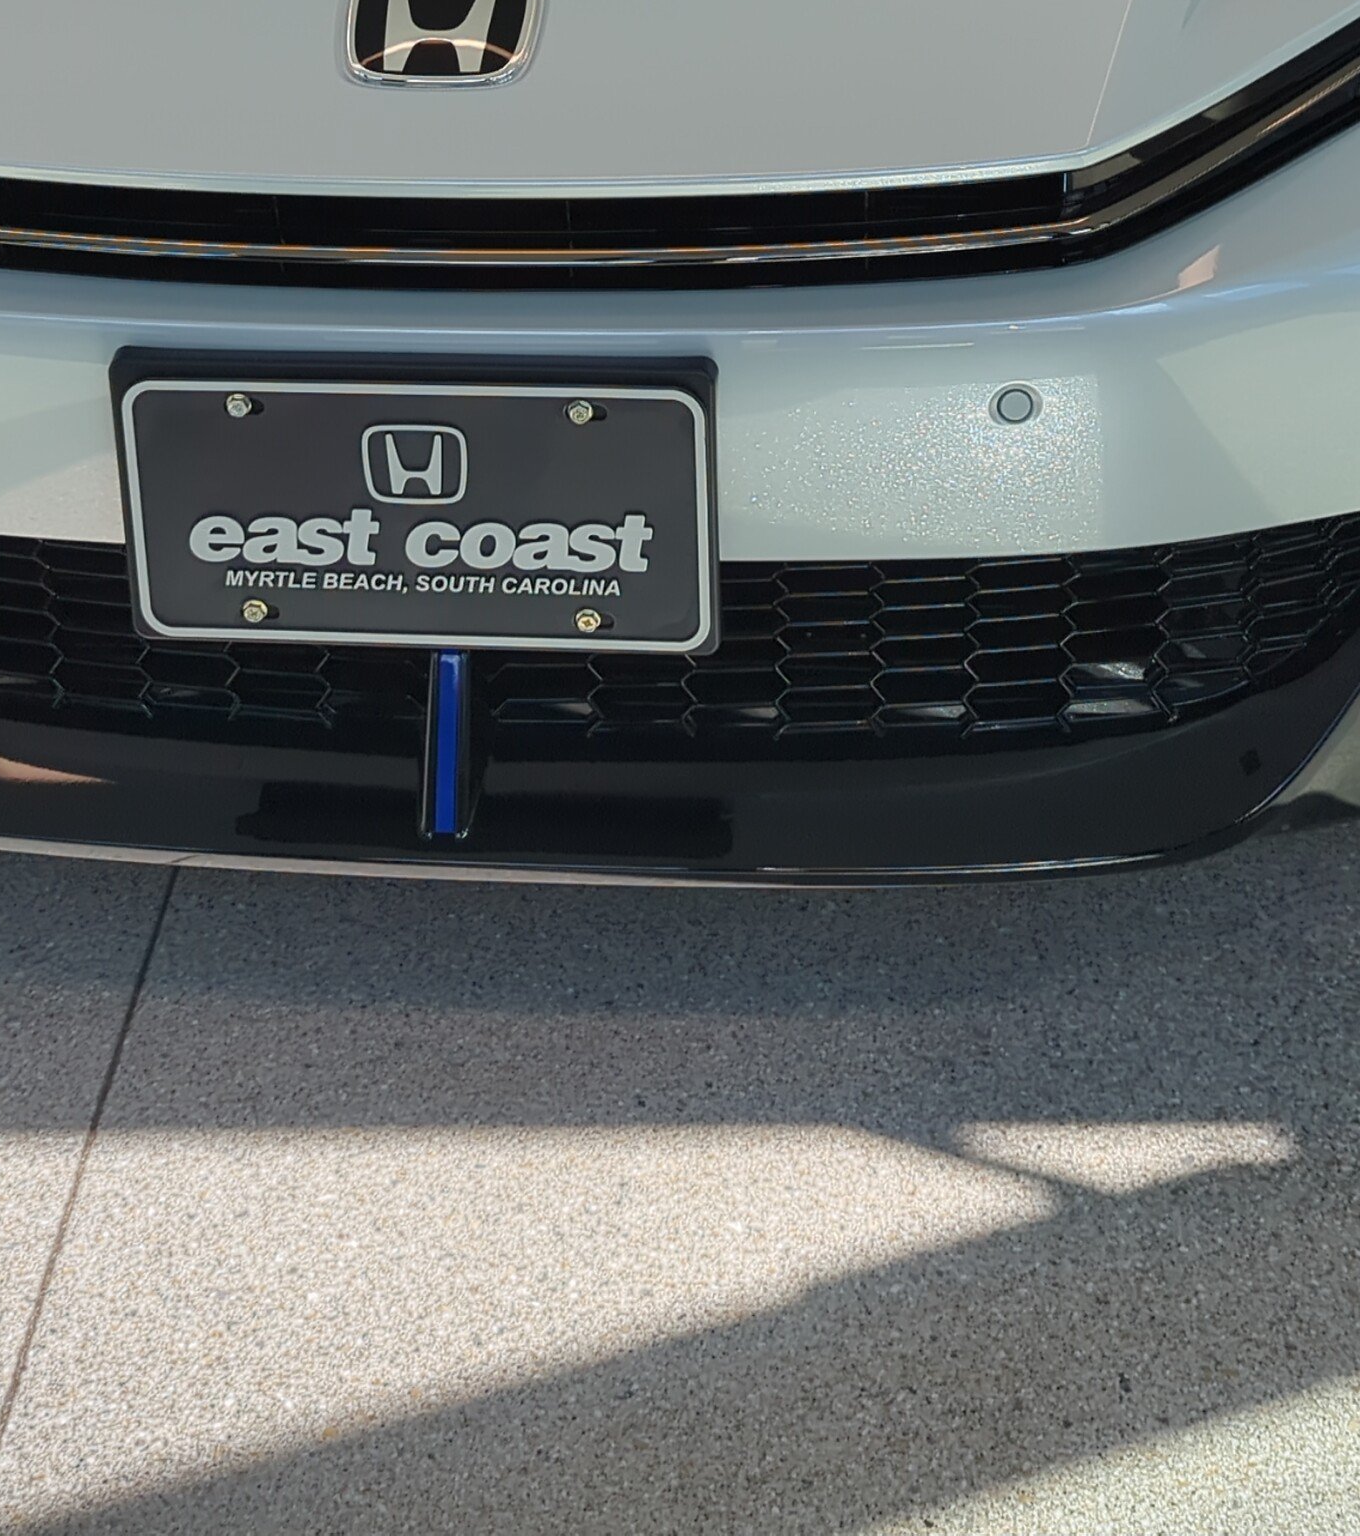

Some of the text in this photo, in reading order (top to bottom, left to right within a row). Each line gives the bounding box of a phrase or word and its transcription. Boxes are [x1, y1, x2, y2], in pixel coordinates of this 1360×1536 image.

[189, 508, 653, 572] east coast
[225, 570, 621, 597] MYRTLE BEACH, SOUTH CAROLINA
